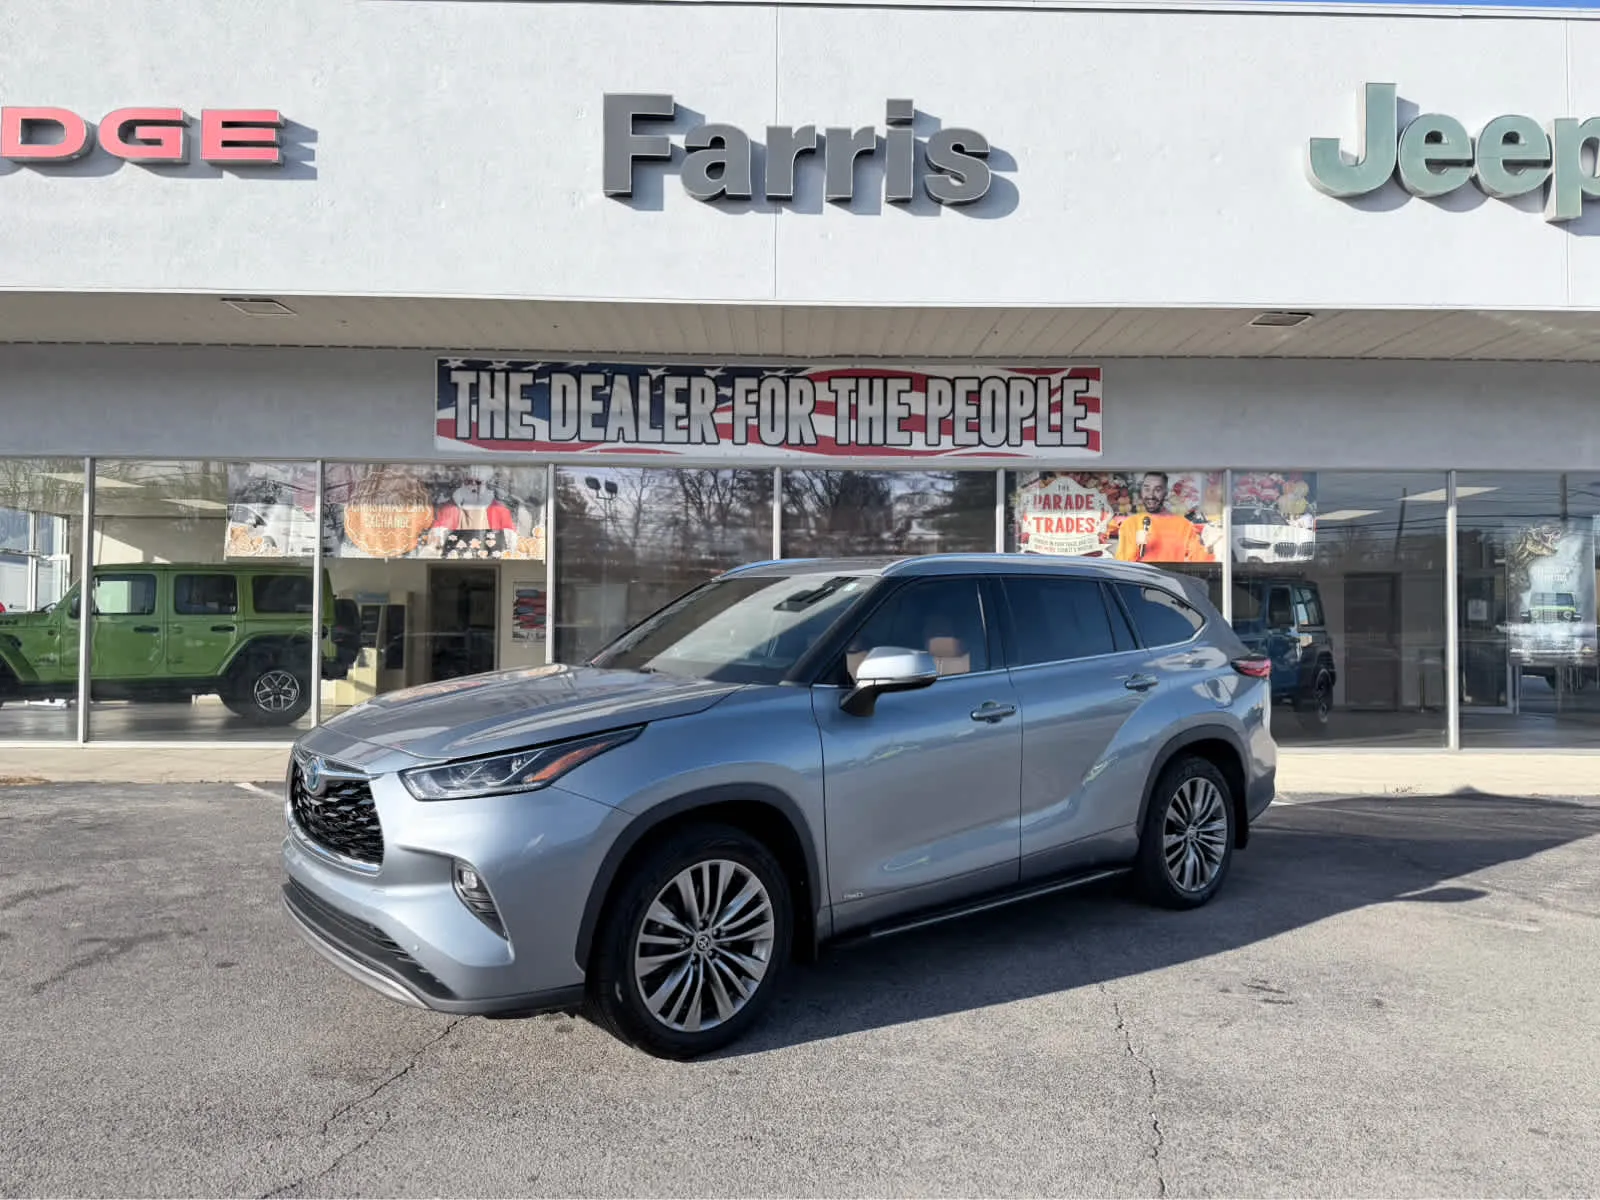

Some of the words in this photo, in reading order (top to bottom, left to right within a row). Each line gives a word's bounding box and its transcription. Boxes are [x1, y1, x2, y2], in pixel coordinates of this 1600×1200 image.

[0, 106, 284, 165] DGE
[602, 93, 992, 204] Farris
[1306, 82, 1600, 221] Jeep
[450, 370, 536, 441] THE
[549, 372, 721, 446] DEALER
[732, 375, 818, 447] FOR
[828, 376, 913, 447] THE
[924, 376, 1090, 448] PEOPLE
[1057, 484, 1070, 492] THE
[351, 499, 405, 513] CHRISTMAS
[1033, 493, 1095, 511] PARADE
[363, 513, 409, 529] EXCHANGE
[1032, 516, 1096, 534] TRADES
